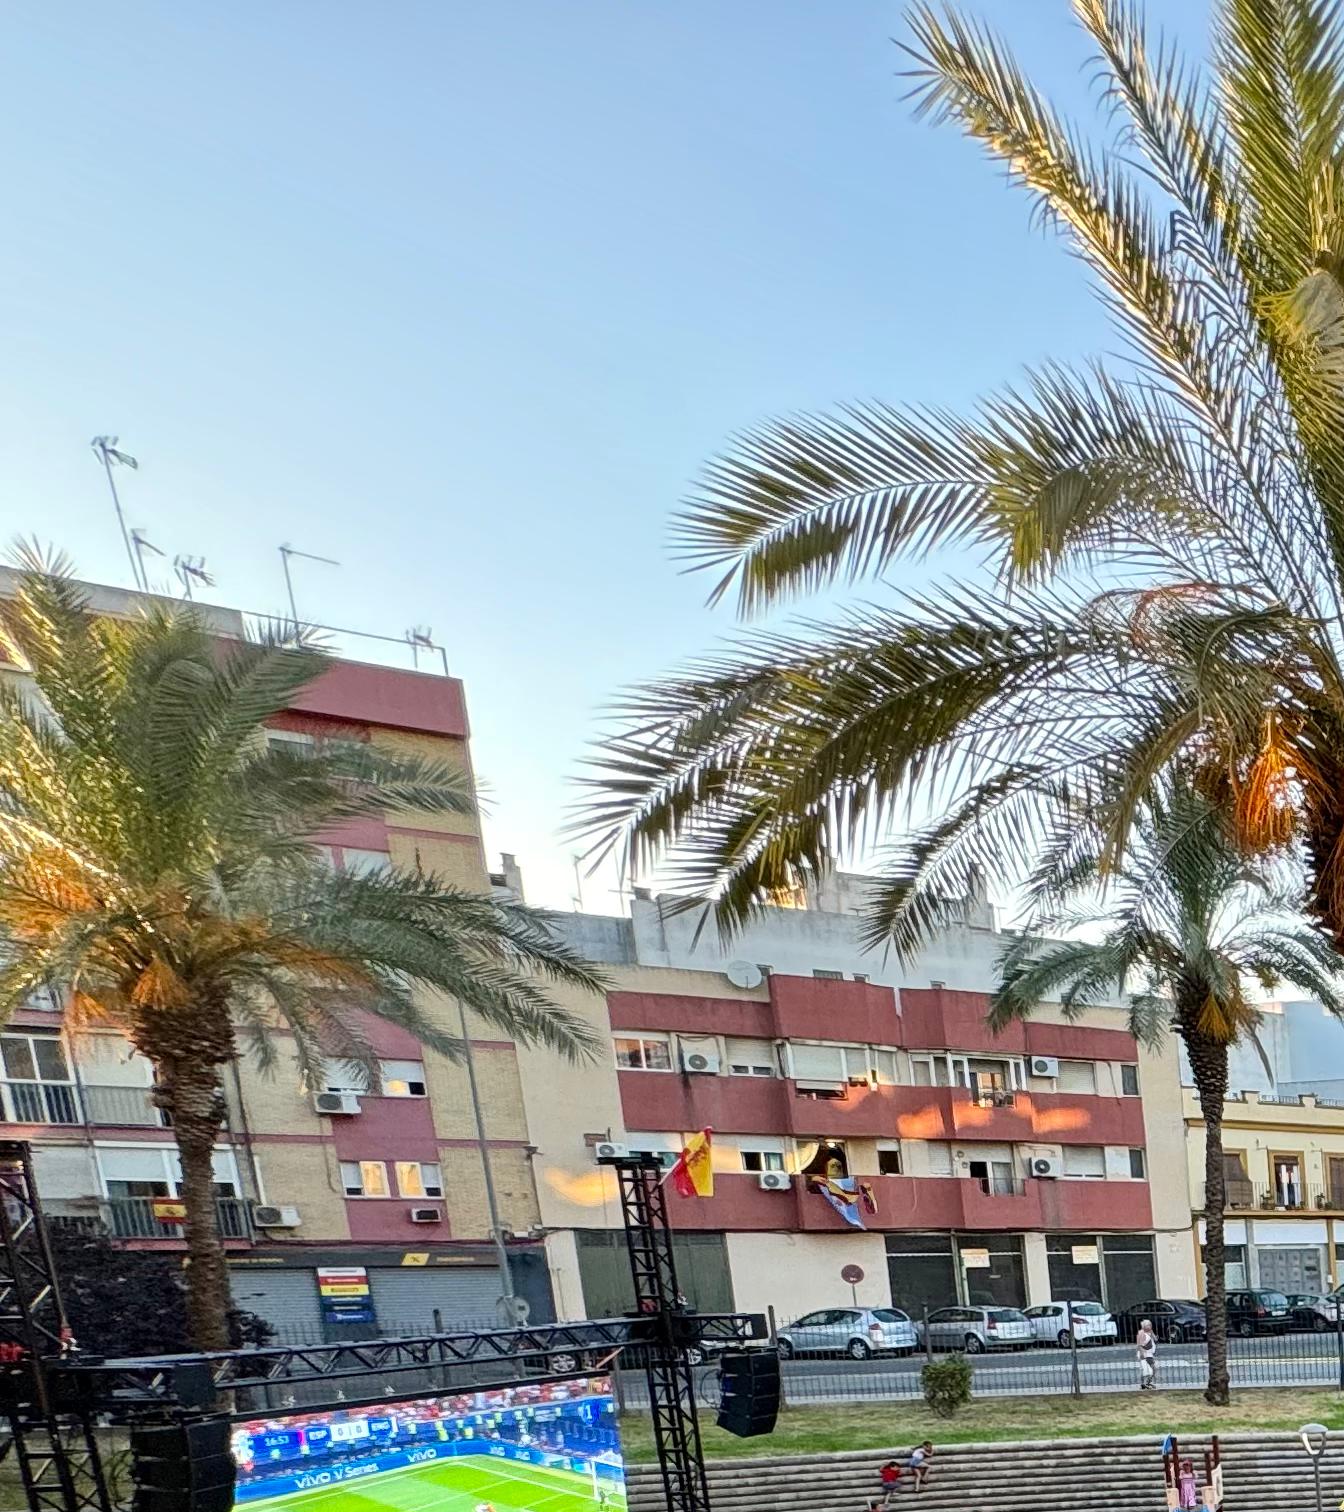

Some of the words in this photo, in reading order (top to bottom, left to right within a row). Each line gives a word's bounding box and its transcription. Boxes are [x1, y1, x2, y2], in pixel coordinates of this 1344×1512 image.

[407, 1448, 437, 1463] vivo
[295, 1473, 331, 1489] vivo
[345, 1462, 380, 1478] Series
